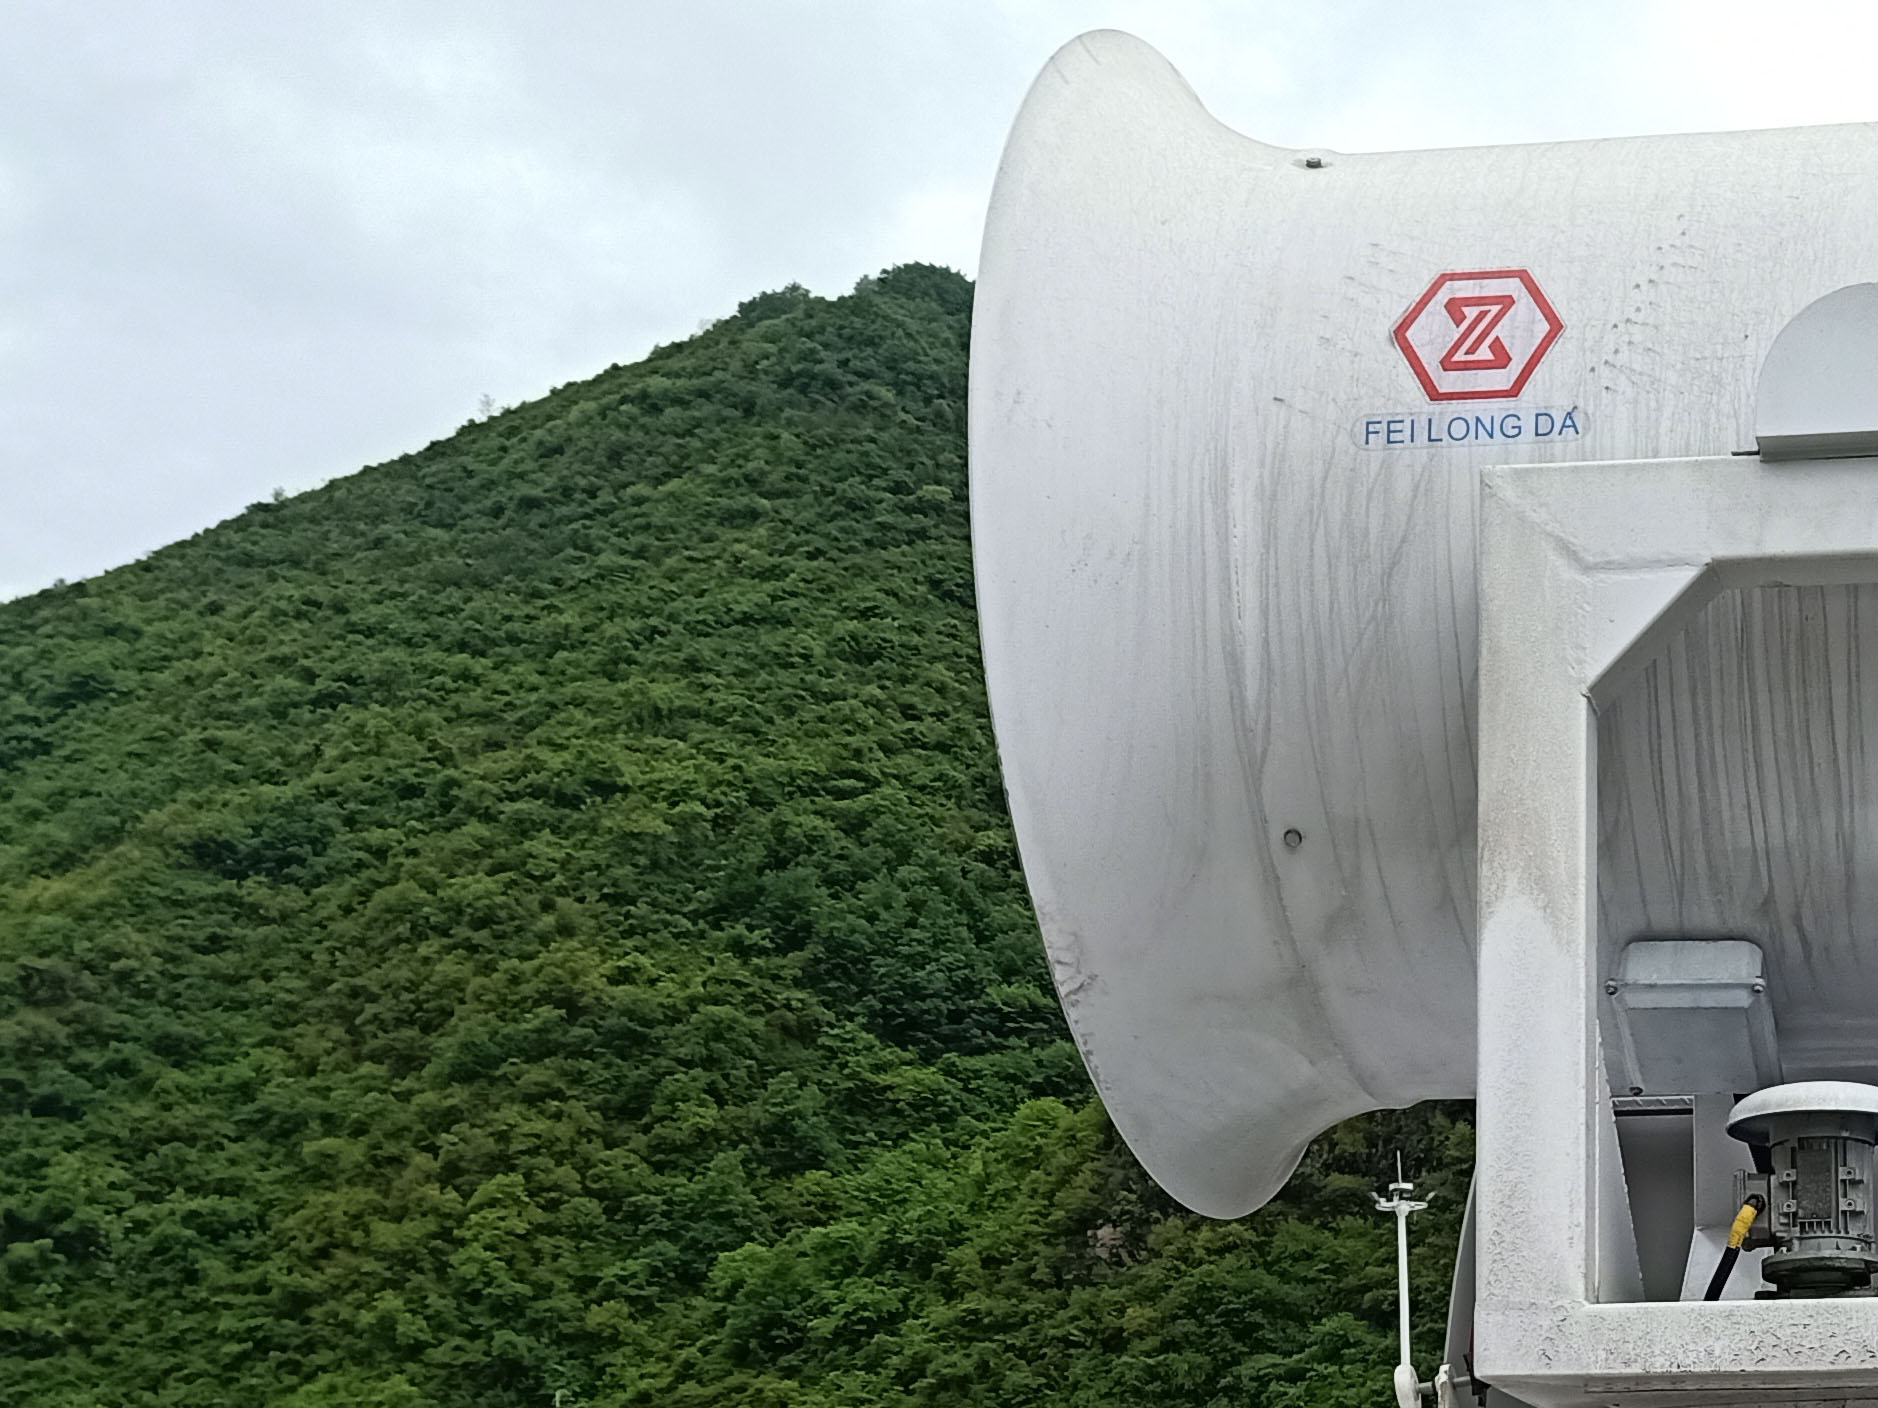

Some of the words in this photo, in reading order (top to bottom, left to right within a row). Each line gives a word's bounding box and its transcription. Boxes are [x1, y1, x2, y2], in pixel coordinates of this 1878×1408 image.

[1364, 418, 1417, 446] FEI
[1427, 413, 1525, 443] LONG
[1534, 410, 1580, 437] DA
